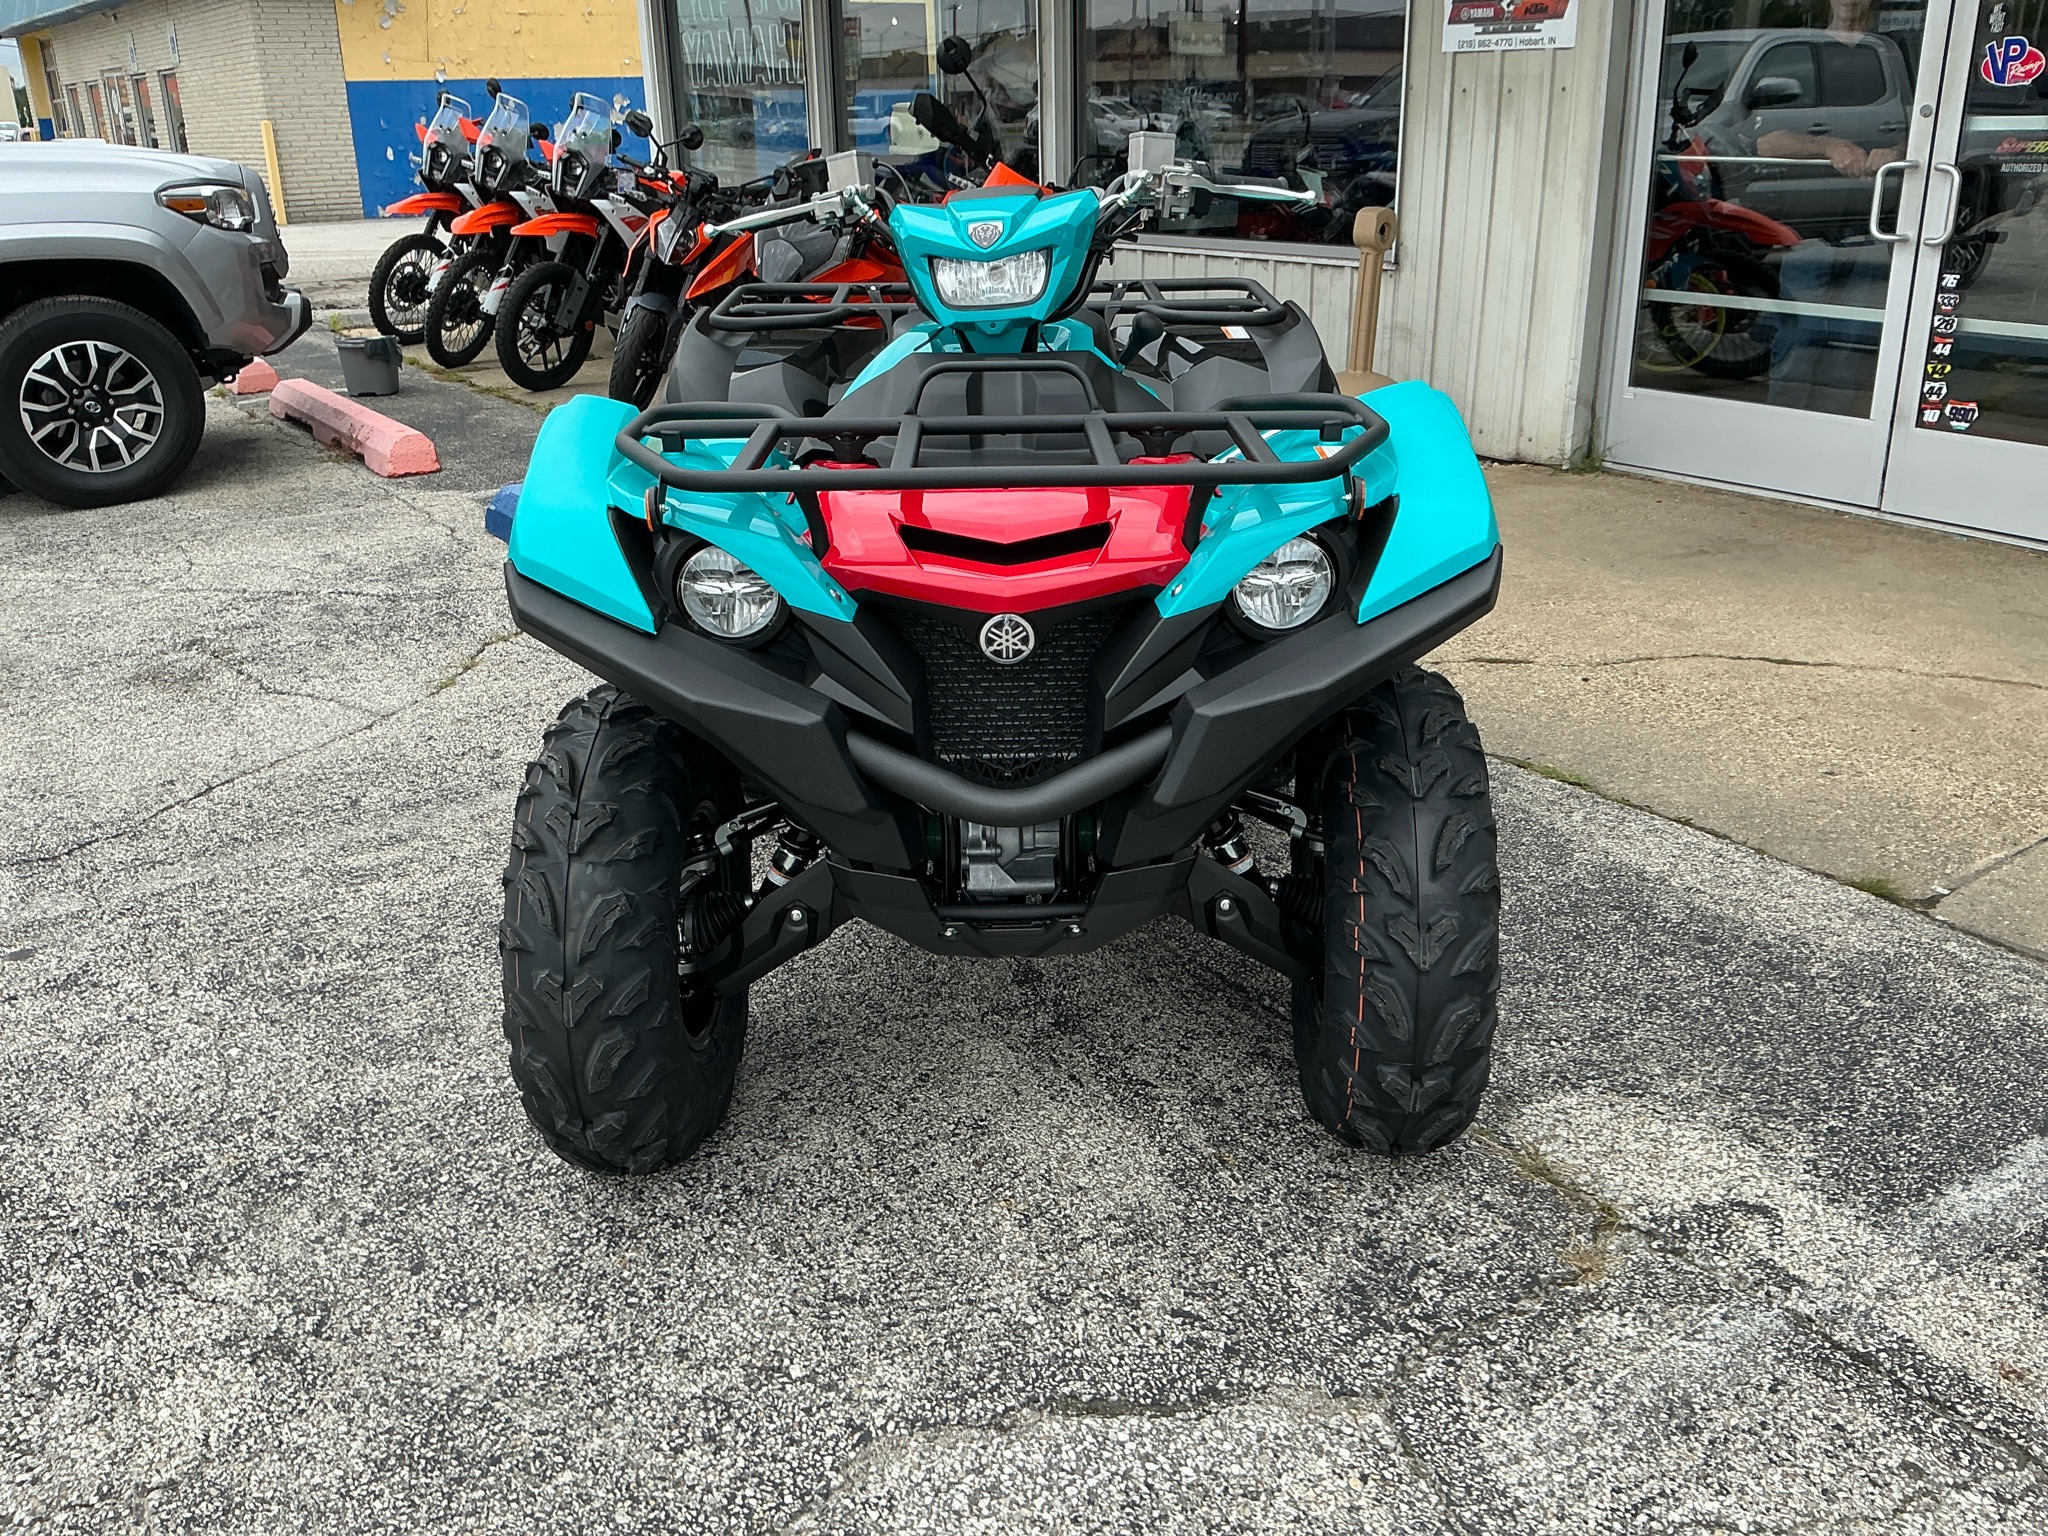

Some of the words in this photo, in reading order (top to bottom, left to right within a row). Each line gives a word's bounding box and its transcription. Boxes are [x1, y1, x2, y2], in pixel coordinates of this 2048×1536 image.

[1470, 7, 1495, 19] YAMAHA
[1524, 3, 1549, 15] KTM
[1519, 37, 1546, 47] Hobart,
[1548, 36, 1556, 45] IN
[1986, 37, 2028, 85] VP
[2009, 60, 2044, 79] Racing
[2000, 163, 2042, 172] AUTHORIZED
[1941, 274, 1960, 288] 76
[1939, 296, 1958, 307] 333
[1935, 317, 1956, 331] 28
[1932, 343, 1952, 356] 44
[1930, 364, 1947, 377] 14
[1925, 386, 1944, 398] 44
[1923, 408, 1941, 422] 10
[1949, 406, 1976, 423] 990
